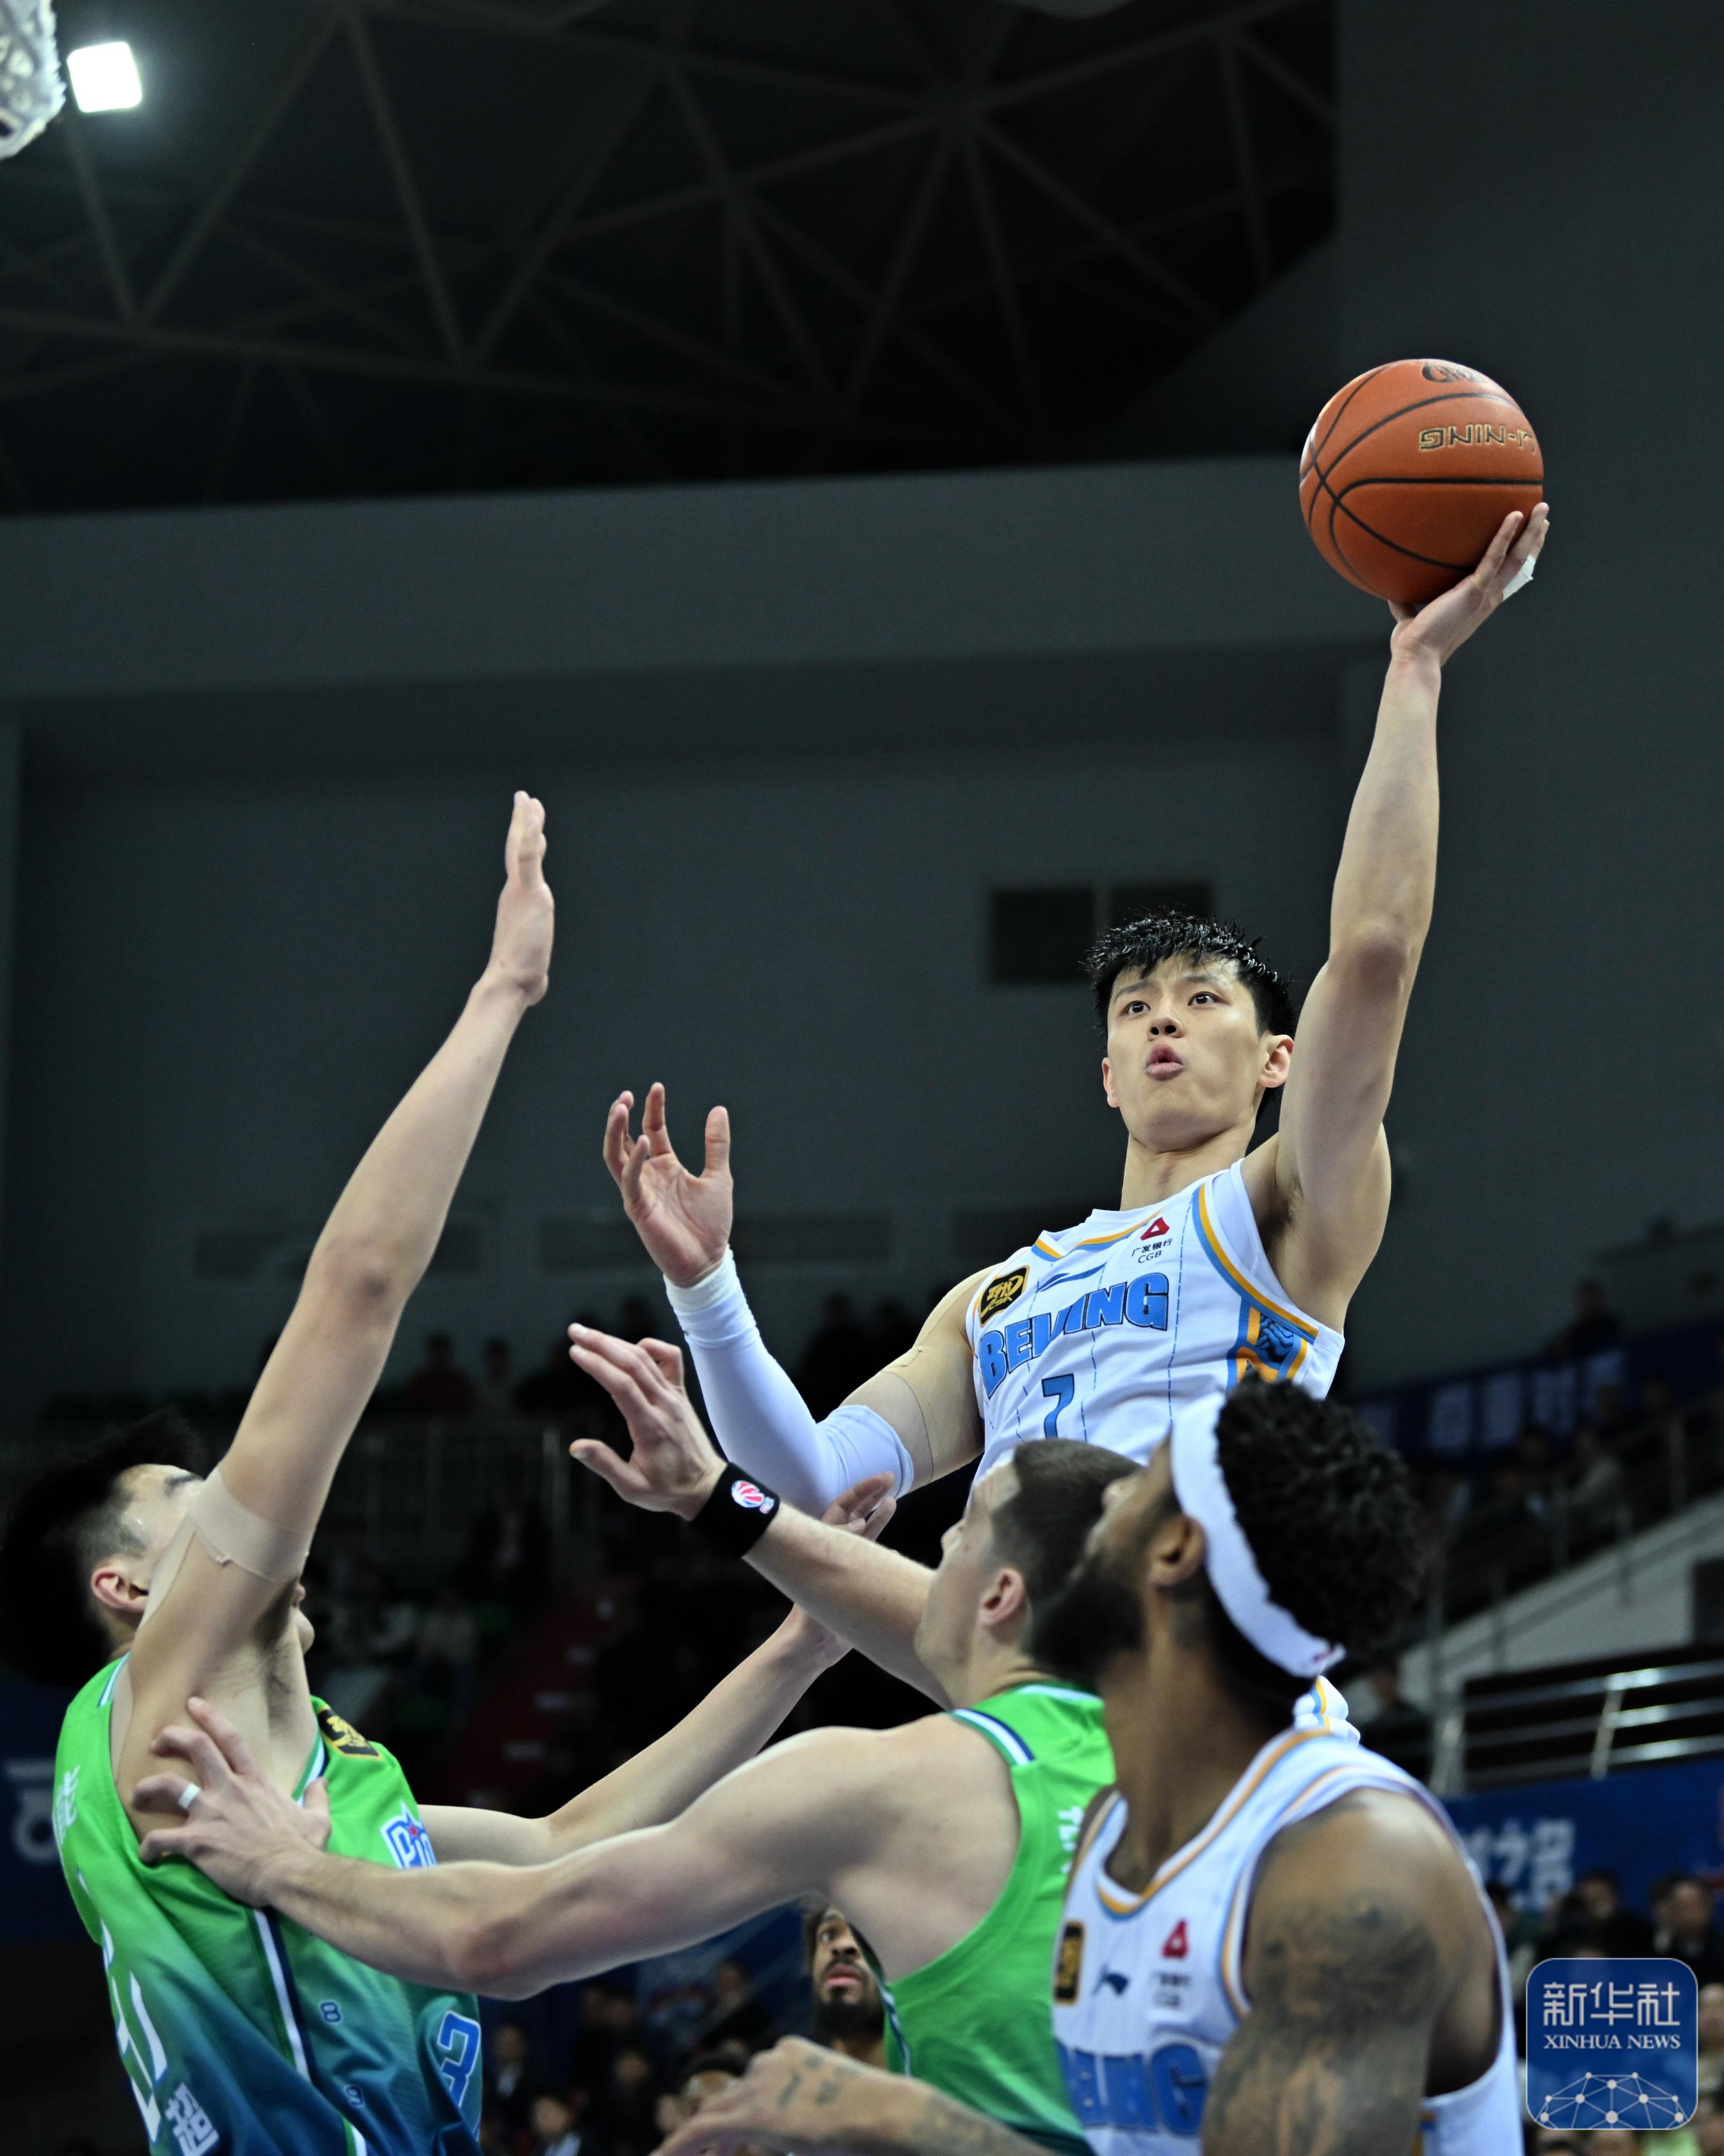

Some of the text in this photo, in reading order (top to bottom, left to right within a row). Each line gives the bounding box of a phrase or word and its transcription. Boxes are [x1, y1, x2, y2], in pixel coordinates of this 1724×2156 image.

[1131, 1238, 1172, 1256] 广发银行
[1138, 1250, 1162, 1263] CGB
[1041, 1373, 1075, 1438] 7
